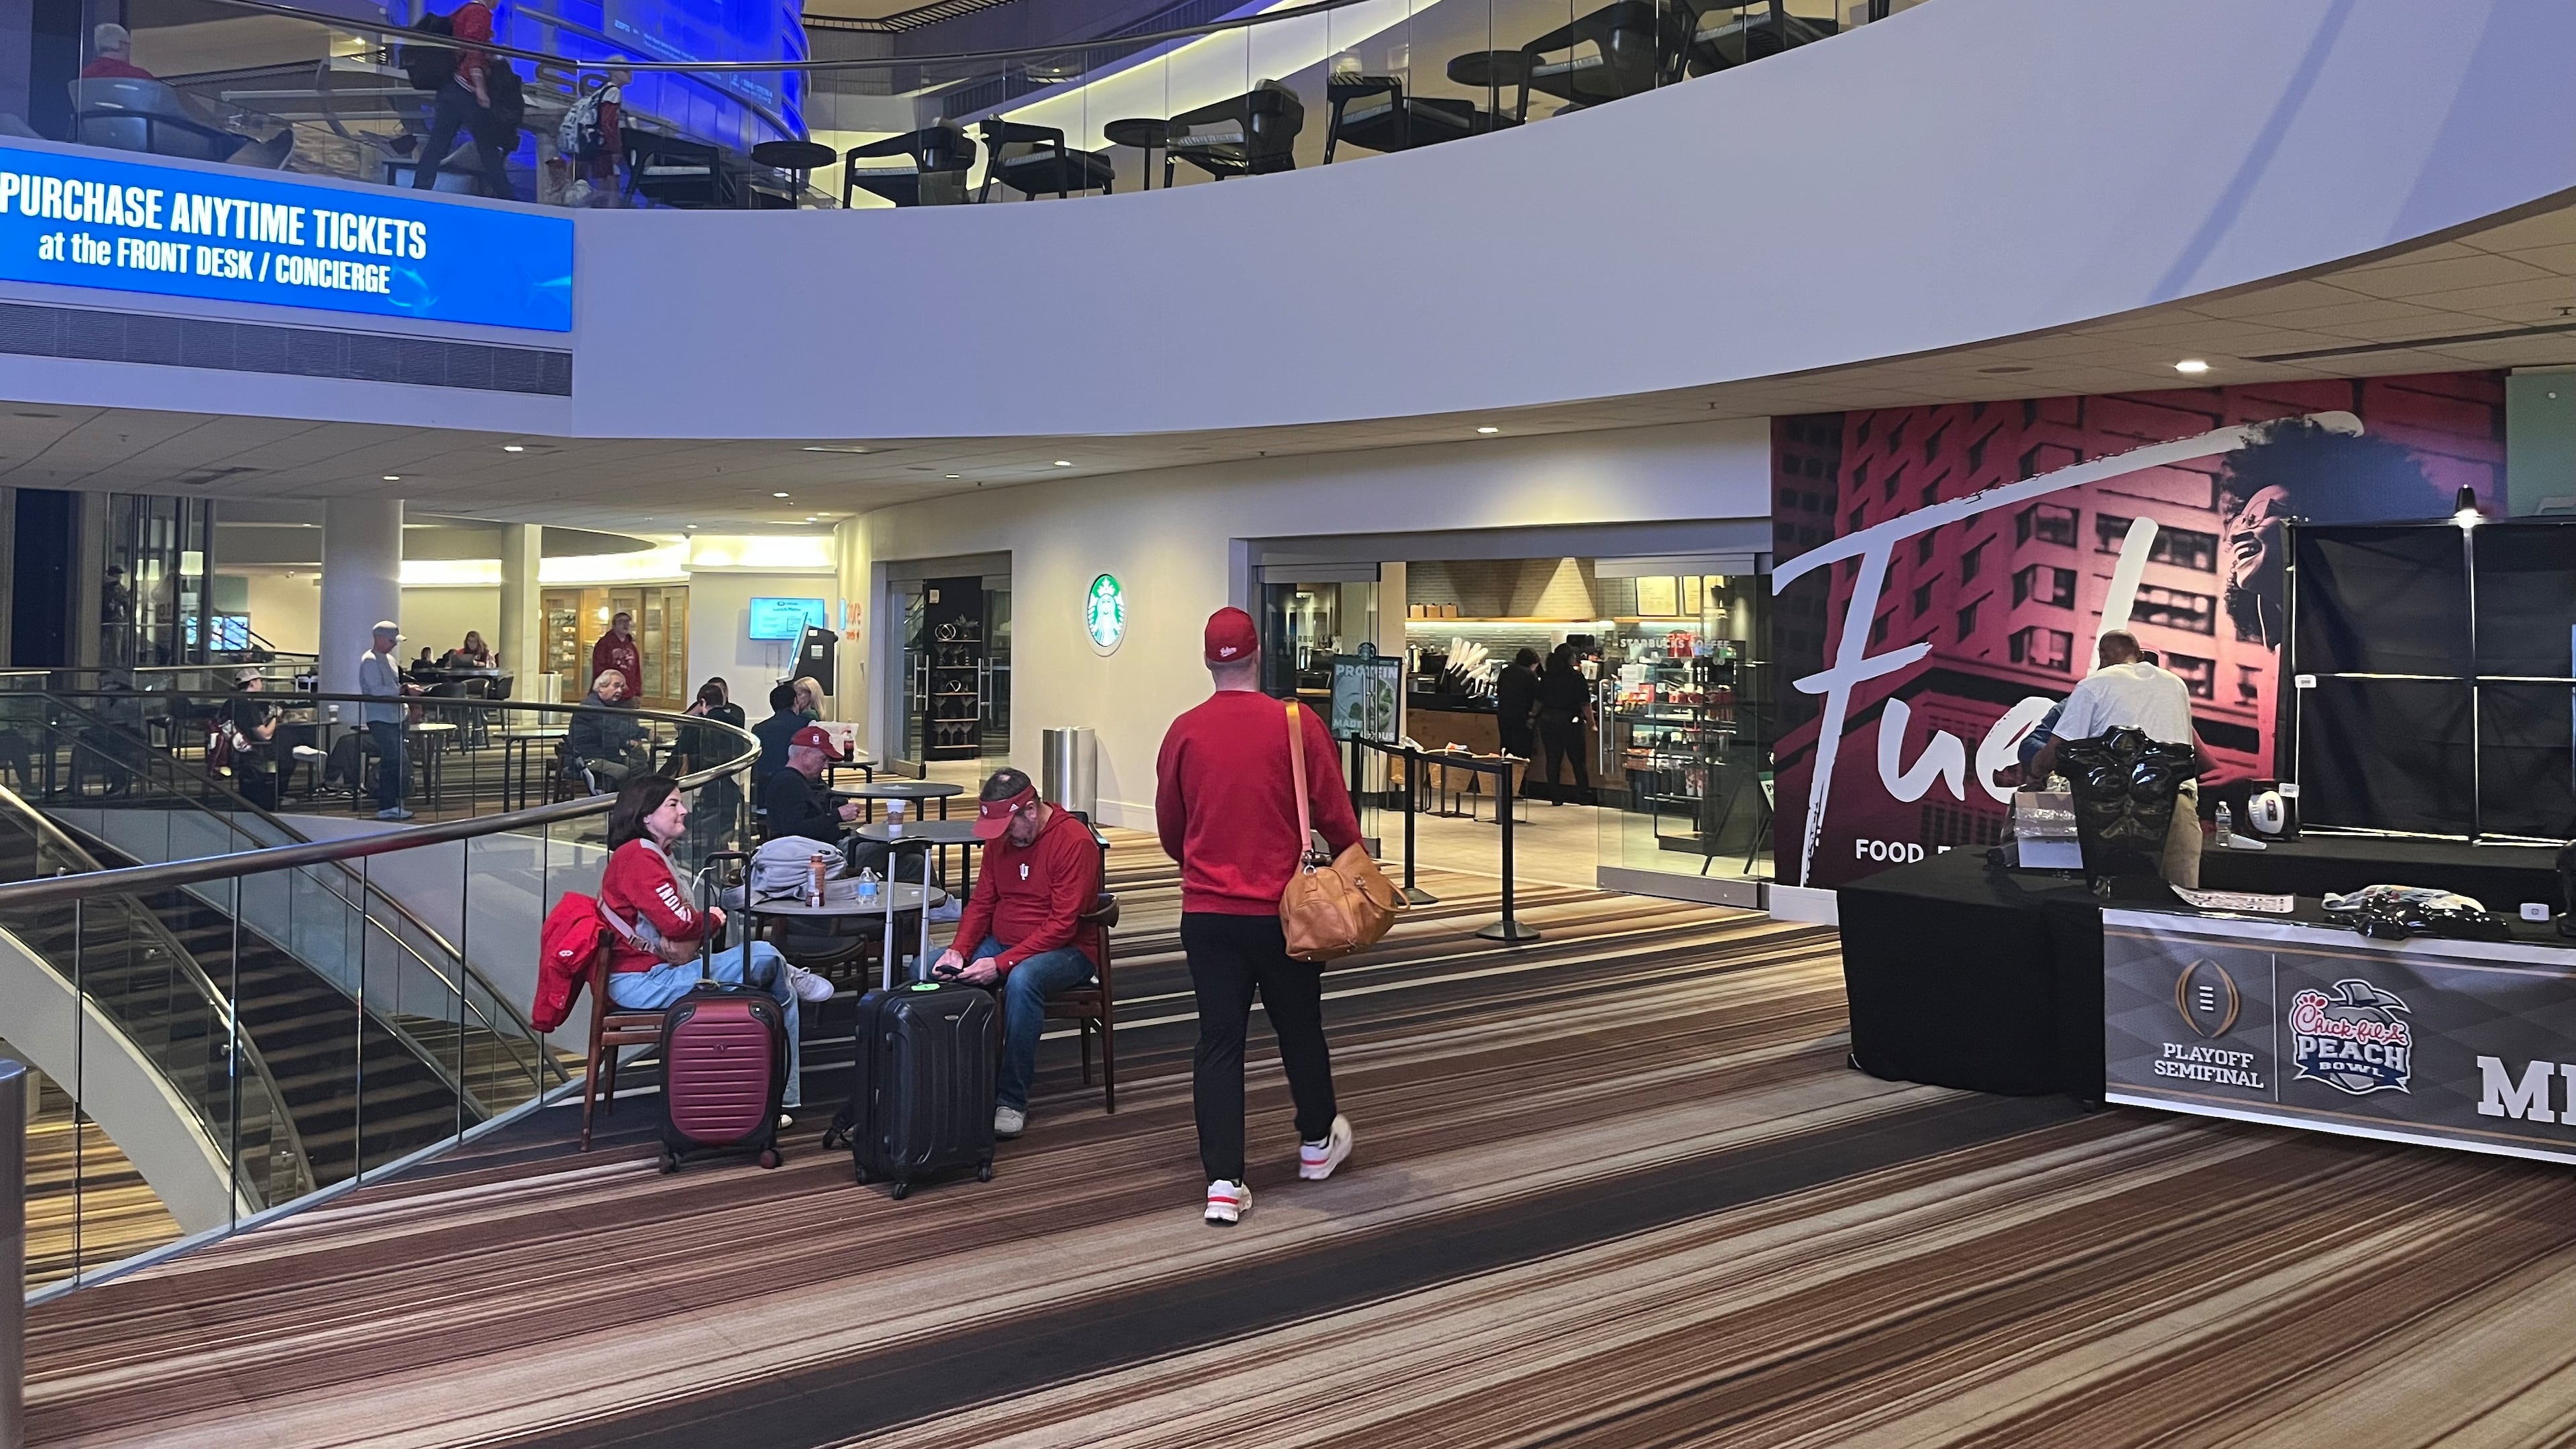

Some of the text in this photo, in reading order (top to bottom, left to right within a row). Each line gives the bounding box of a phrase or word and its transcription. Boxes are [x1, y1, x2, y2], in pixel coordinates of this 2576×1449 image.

[0, 172, 427, 260] PURCHASE ANYTIME TICKETS
[39, 232, 391, 294] at the FRONT DESK / CONCIERGE
[1620, 638, 1685, 649] STARBUCKS
[1333, 719, 1363, 728] MADE
[1856, 839, 1924, 863] FOOD
[2296, 996, 2408, 1044] Chick-fil-A
[2163, 1042, 2254, 1069] PLAYOFF
[2298, 1036, 2406, 1073] PEACH
[2154, 1059, 2265, 1089] SEMIFINAL
[2319, 1061, 2385, 1078] BOWL
